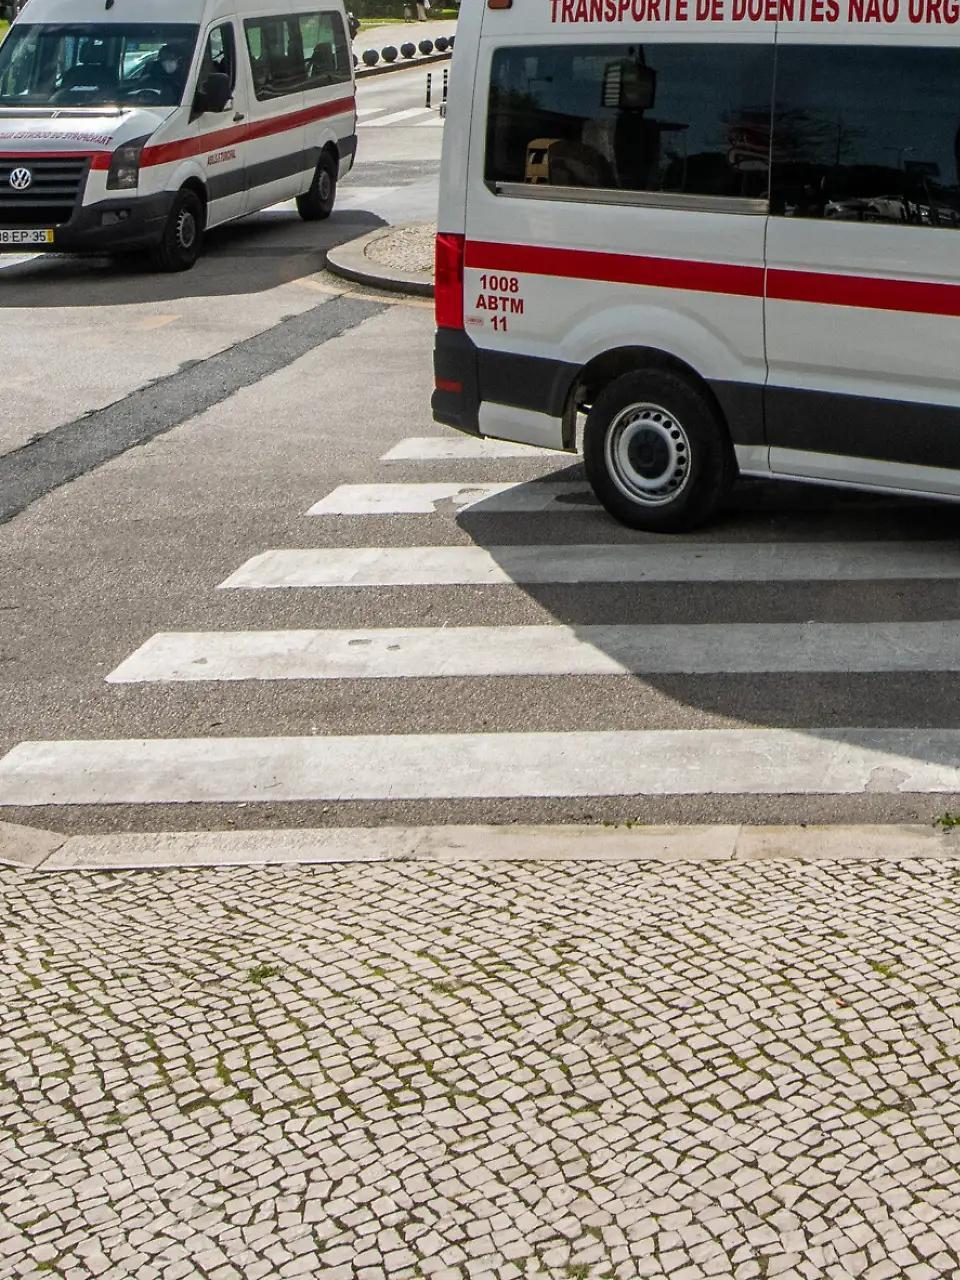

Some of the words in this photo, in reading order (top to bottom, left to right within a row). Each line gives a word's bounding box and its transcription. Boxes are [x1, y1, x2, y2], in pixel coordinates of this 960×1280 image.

[479, 274, 519, 293] 1008
[475, 294, 524, 314] ABTM
[490, 315, 508, 332] 11
